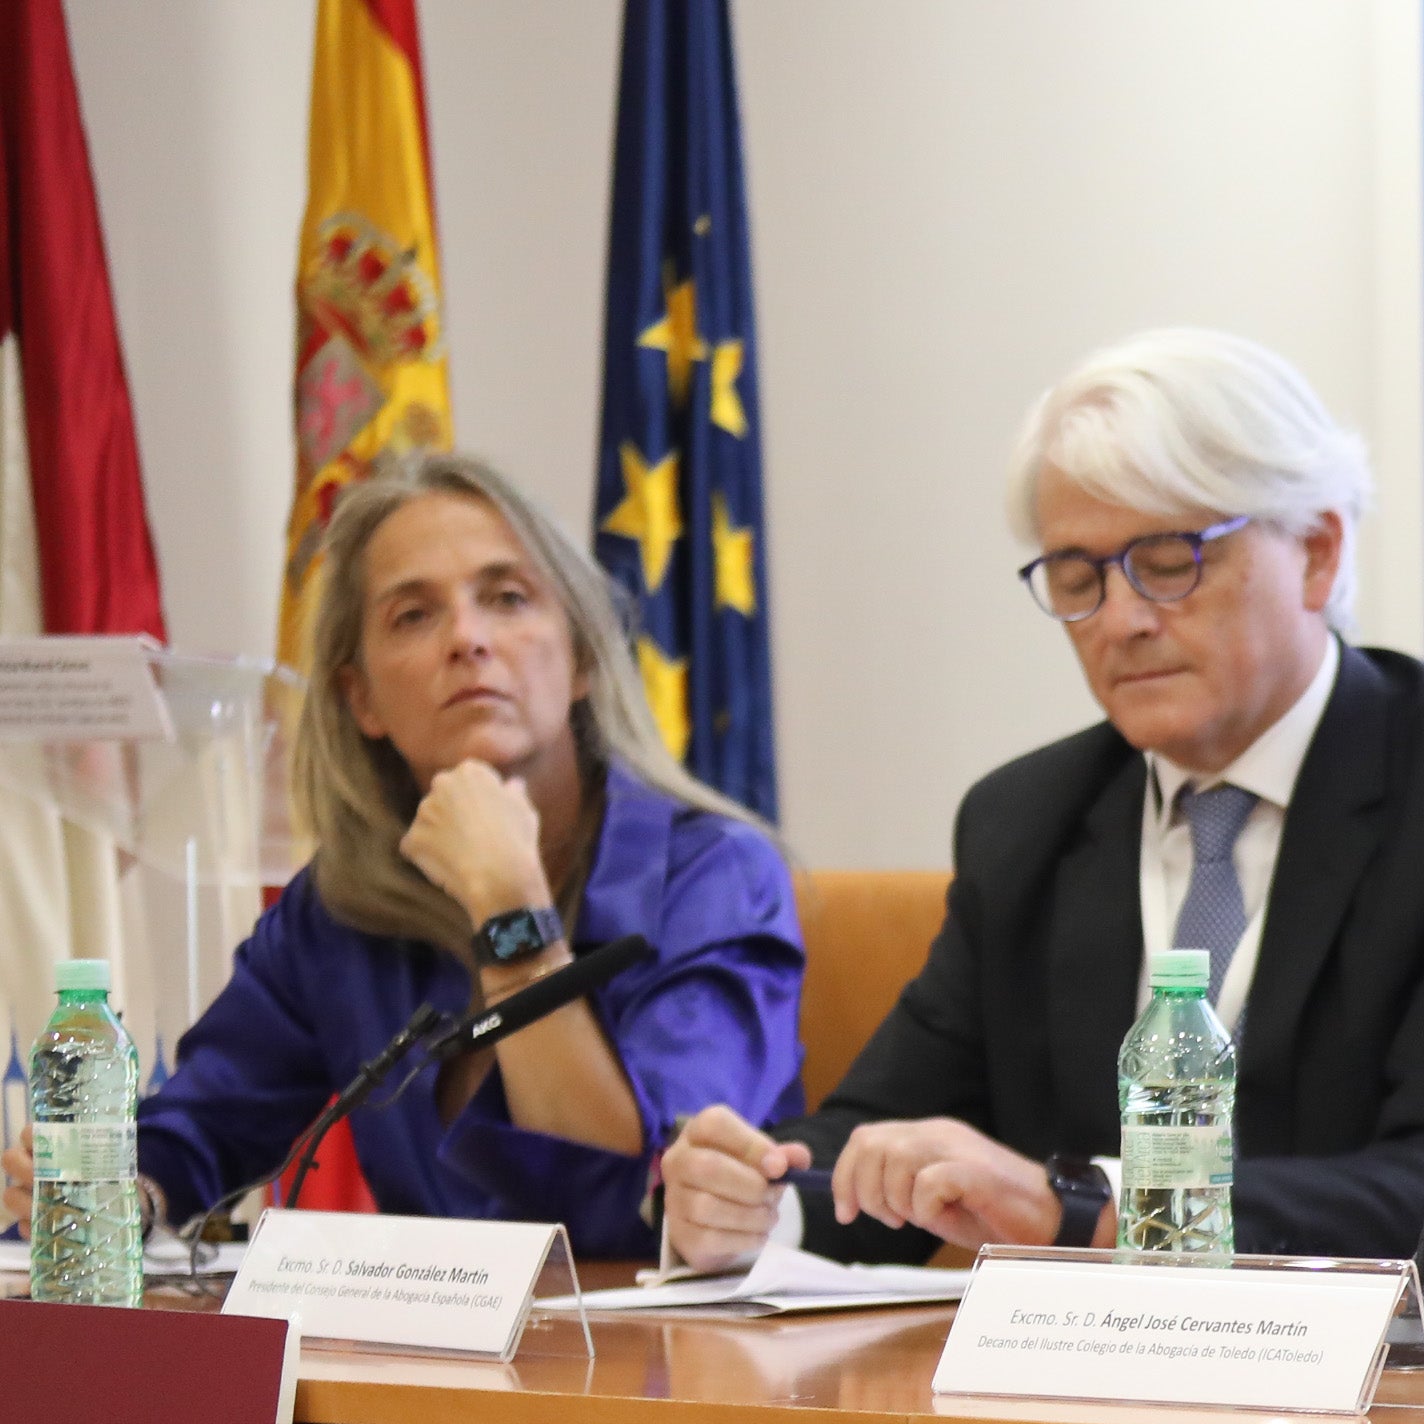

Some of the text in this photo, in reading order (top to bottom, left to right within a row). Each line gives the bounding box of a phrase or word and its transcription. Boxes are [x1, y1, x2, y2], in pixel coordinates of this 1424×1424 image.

[345, 1260, 395, 1278] Salvador
[395, 1263, 447, 1282] González
[448, 1267, 489, 1285] Martín
[1010, 1308, 1308, 1337] Excmo. Sr. D. Ángel José Cervantes Martín
[977, 1335, 1018, 1349] Decano
[1020, 1336, 1039, 1350] del
[1039, 1338, 1074, 1352] Ilustre
[1076, 1339, 1117, 1356] Colegio
[1119, 1341, 1134, 1354] de
[1136, 1342, 1145, 1355] la
[1147, 1342, 1199, 1359] Abogacía
[1201, 1345, 1216, 1358] de
[1218, 1346, 1256, 1360] Toledo
